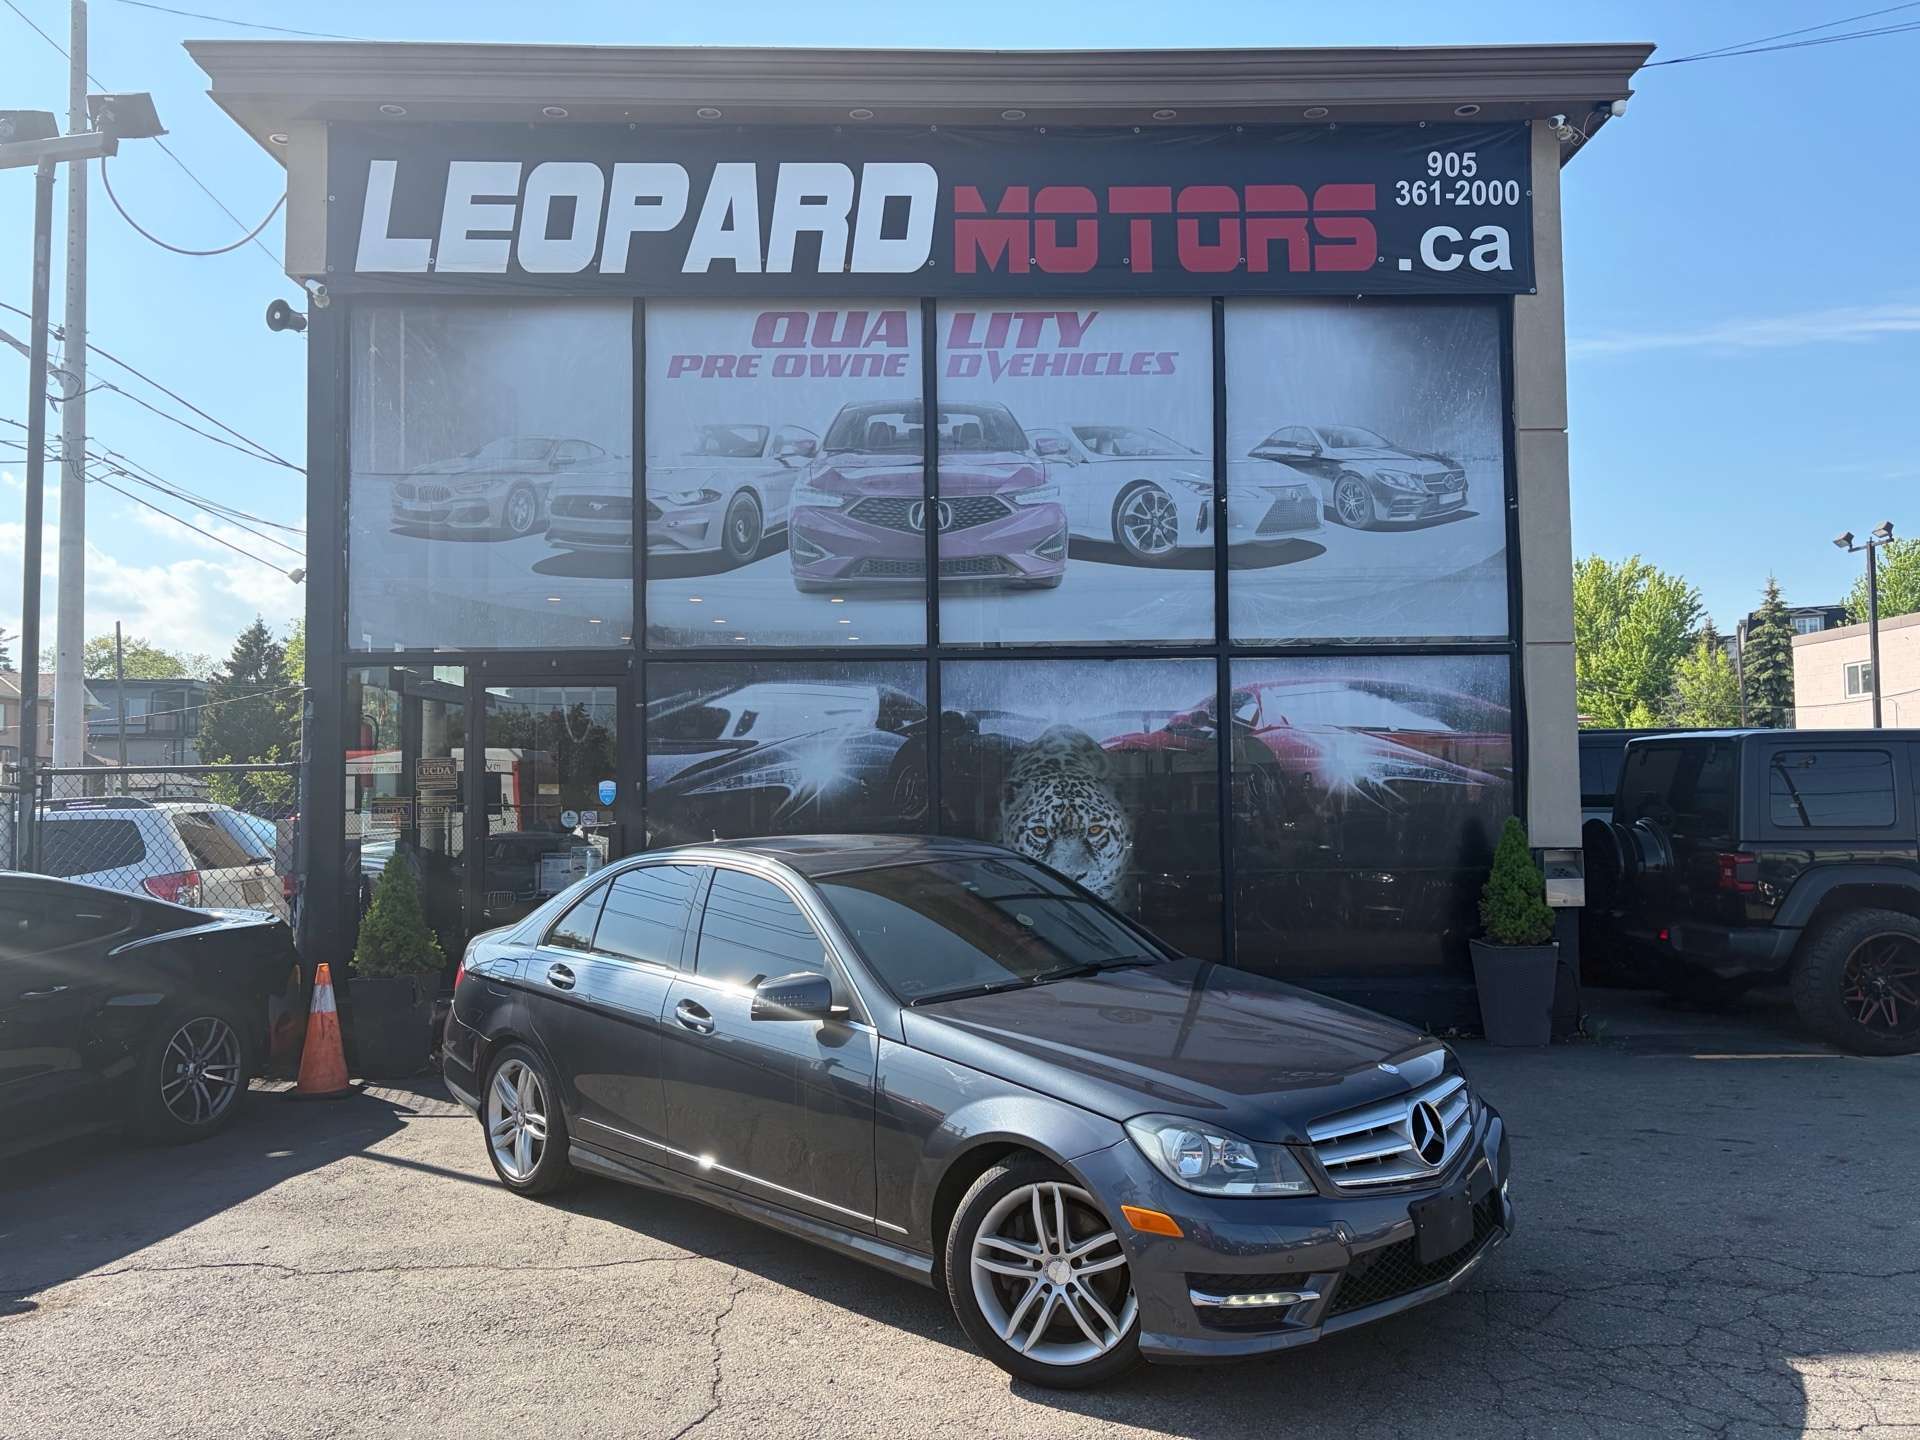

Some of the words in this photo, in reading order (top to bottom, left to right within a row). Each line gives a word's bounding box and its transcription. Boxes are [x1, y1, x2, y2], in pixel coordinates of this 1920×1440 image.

[1427, 151, 1477, 177] 905
[1395, 180, 1520, 206] 361-2000
[355, 160, 939, 273] LEOPARD
[954, 184, 1377, 273] MOTORS
[1398, 225, 1513, 271] .ca
[667, 354, 762, 378] PRE
[423, 767, 451, 775] UCDA
